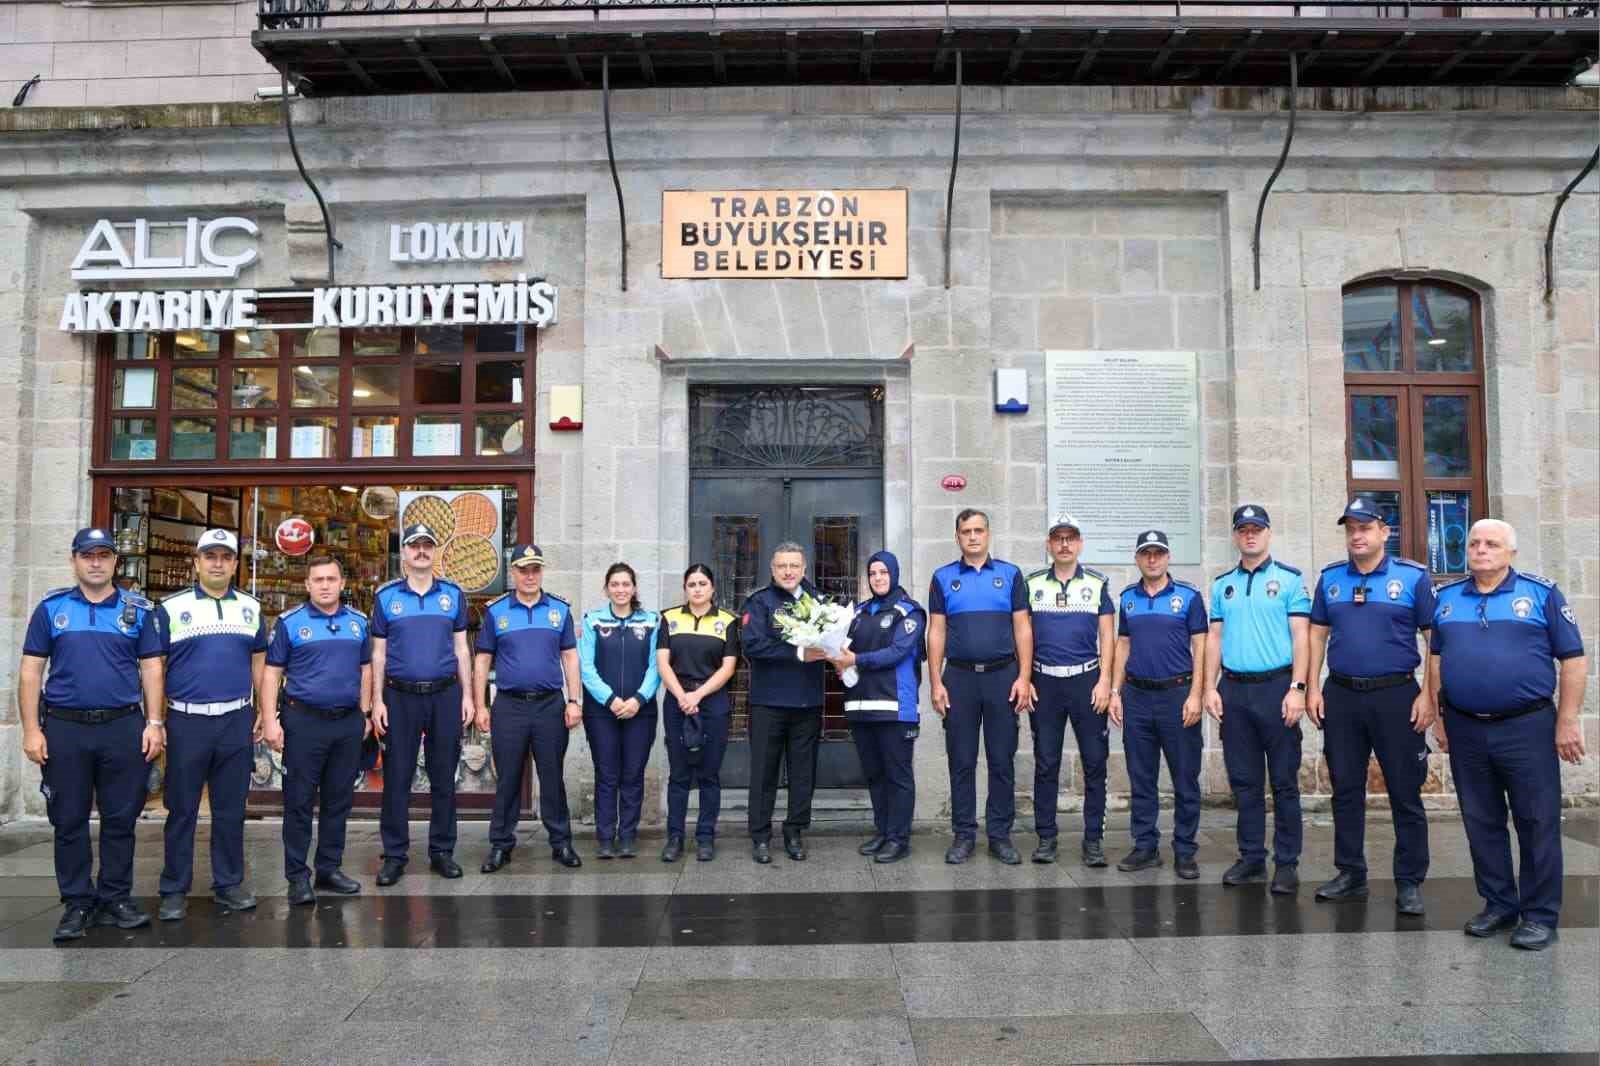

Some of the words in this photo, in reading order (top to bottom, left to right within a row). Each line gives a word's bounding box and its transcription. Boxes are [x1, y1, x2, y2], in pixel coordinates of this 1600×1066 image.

[711, 196, 859, 217] TRABZON
[71, 216, 260, 279] ALIÇ
[390, 221, 524, 262] LOKUM
[681, 221, 888, 248] BÜYÜKŞEHİR
[694, 249, 876, 272] BELEDİYESİ
[59, 288, 258, 331] AKTARIYE
[312, 273, 558, 329] KURUYEMİŞ
